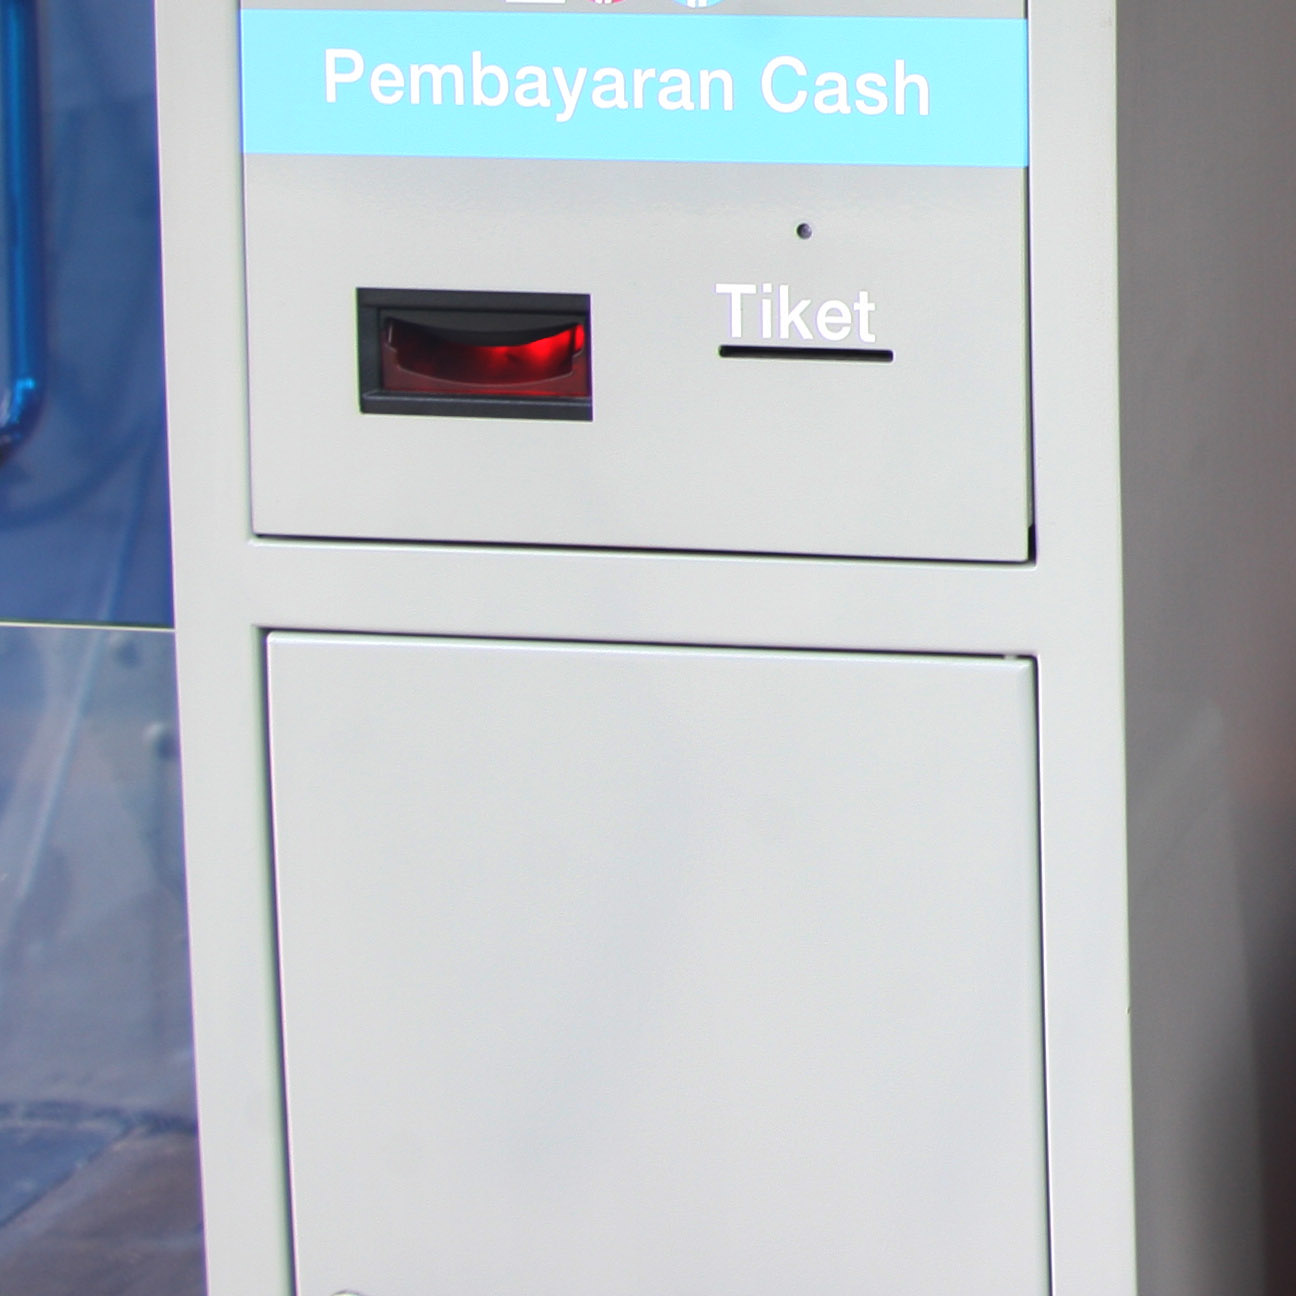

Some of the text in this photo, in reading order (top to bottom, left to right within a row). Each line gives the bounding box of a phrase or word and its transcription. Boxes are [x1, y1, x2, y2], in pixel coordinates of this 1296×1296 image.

[323, 49, 931, 122] Pembayaran Cash
[715, 283, 876, 344] Tiket
